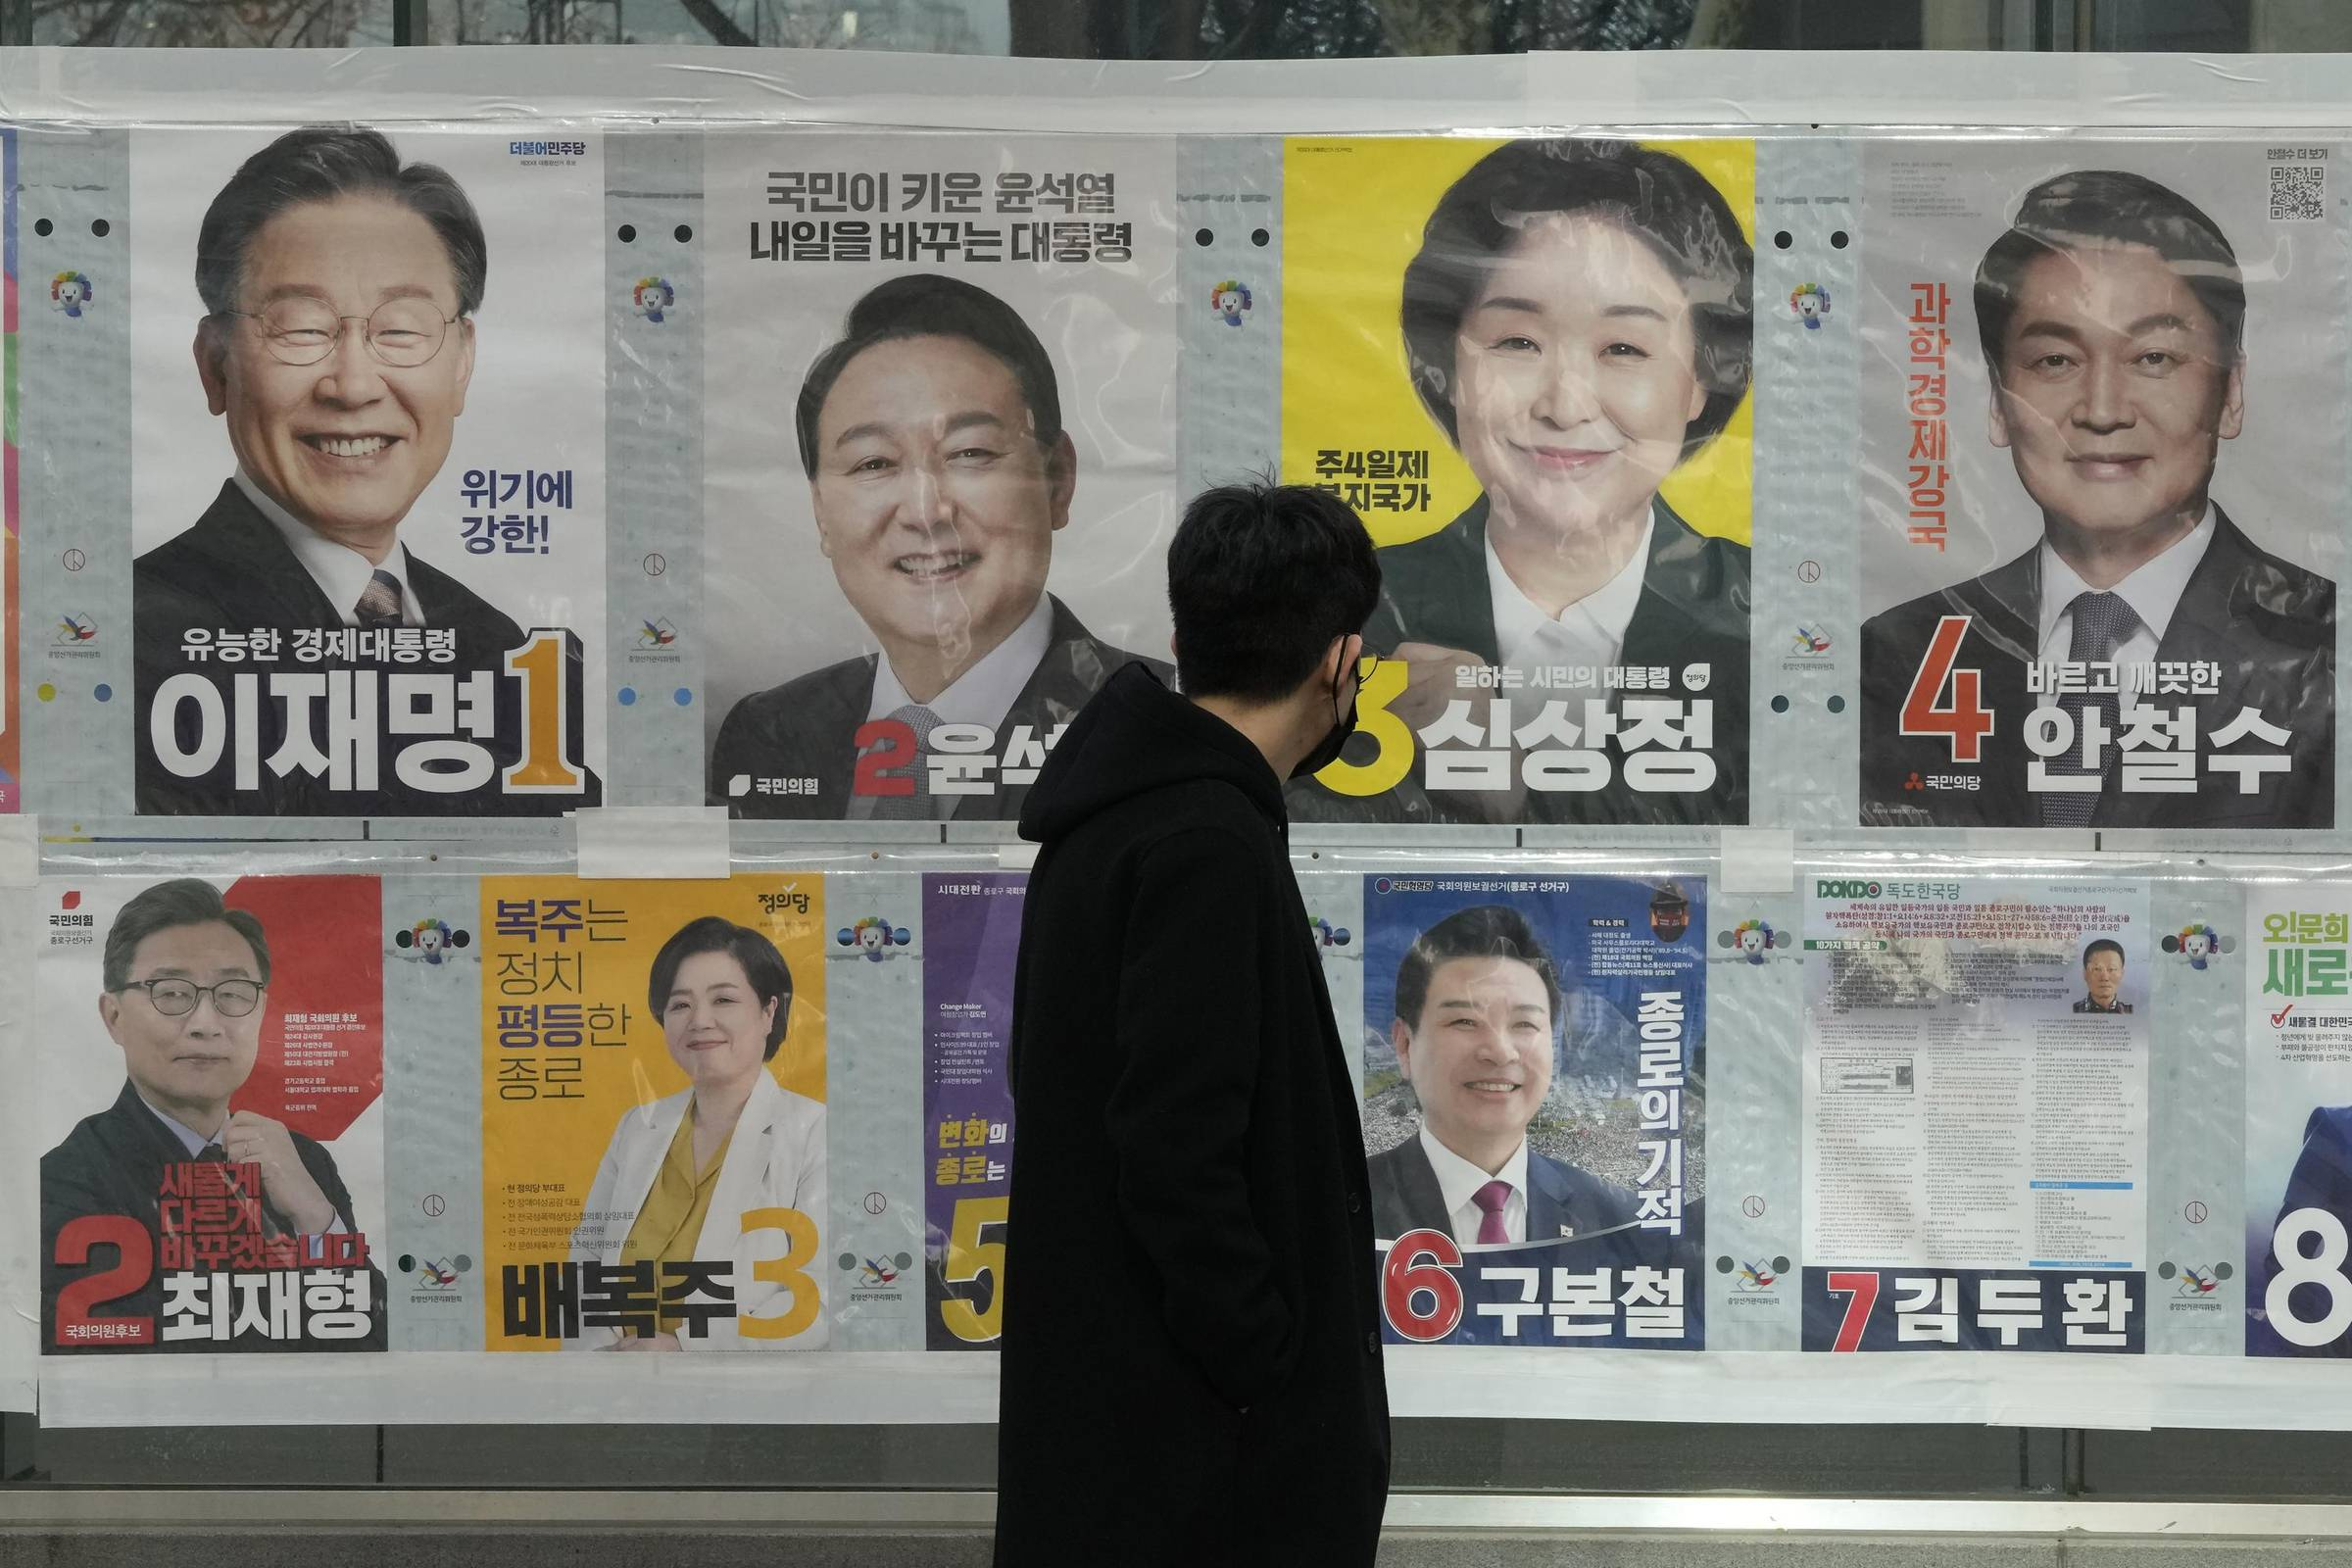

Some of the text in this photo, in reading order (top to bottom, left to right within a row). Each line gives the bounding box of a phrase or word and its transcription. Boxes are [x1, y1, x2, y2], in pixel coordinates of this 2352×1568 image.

[510, 141, 586, 155] 더불어민주당
[2267, 149, 2328, 160] 안철수 더 보기
[766, 172, 1115, 214] 국민이 키운 윤석열
[750, 221, 1133, 263] 내일을 바꾸는 대통령
[1315, 450, 1429, 479] 주4일제
[461, 469, 573, 510] 위기에
[461, 514, 550, 555] 강한!
[181, 628, 456, 662] 유능한 경제대통령
[1454, 665, 1523, 689] 일하는
[1530, 665, 1597, 689] 시민의
[1603, 665, 1671, 690] 대통령
[1899, 615, 1994, 763] 4
[2026, 661, 2222, 696] 바르고 깨끗한
[150, 628, 585, 794] 이재명 1
[1312, 657, 1717, 797] 3 심상정
[757, 777, 819, 796] 국민의힘
[854, 719, 917, 797] 2
[2023, 706, 2292, 795] 안철수
[1925, 774, 1981, 791] 국민의당
[759, 894, 810, 914] 정의당
[938, 885, 981, 896] 시대전환
[1817, 880, 1960, 900] DOKDO 독도한국당
[49, 914, 93, 926] 국민의힘
[50, 936, 93, 945] 종로구선거구
[495, 899, 628, 943] 복주는
[497, 951, 583, 995] 정치
[2263, 949, 2352, 998] 새로
[497, 1003, 632, 1048] 평등한
[497, 1057, 585, 1101] 종로
[938, 1118, 1007, 1149] 변화의
[160, 1161, 262, 1199] 새롭게
[517, 1184, 540, 1193] 정의당
[543, 1184, 565, 1193] 부대표
[936, 1154, 1005, 1186] 종로는
[160, 1199, 262, 1234] 다르게
[160, 1233, 370, 1269] 바꾸겠습니다
[941, 1197, 1009, 1343] 5
[55, 1214, 372, 1346] 2 최재형
[502, 1206, 820, 1340] 배복주 3
[1382, 1228, 1686, 1343] 6 구본철
[2265, 1207, 2352, 1347] 8
[66, 1324, 141, 1339] 국회의원후보
[1827, 1271, 2133, 1353] 7 김두환
